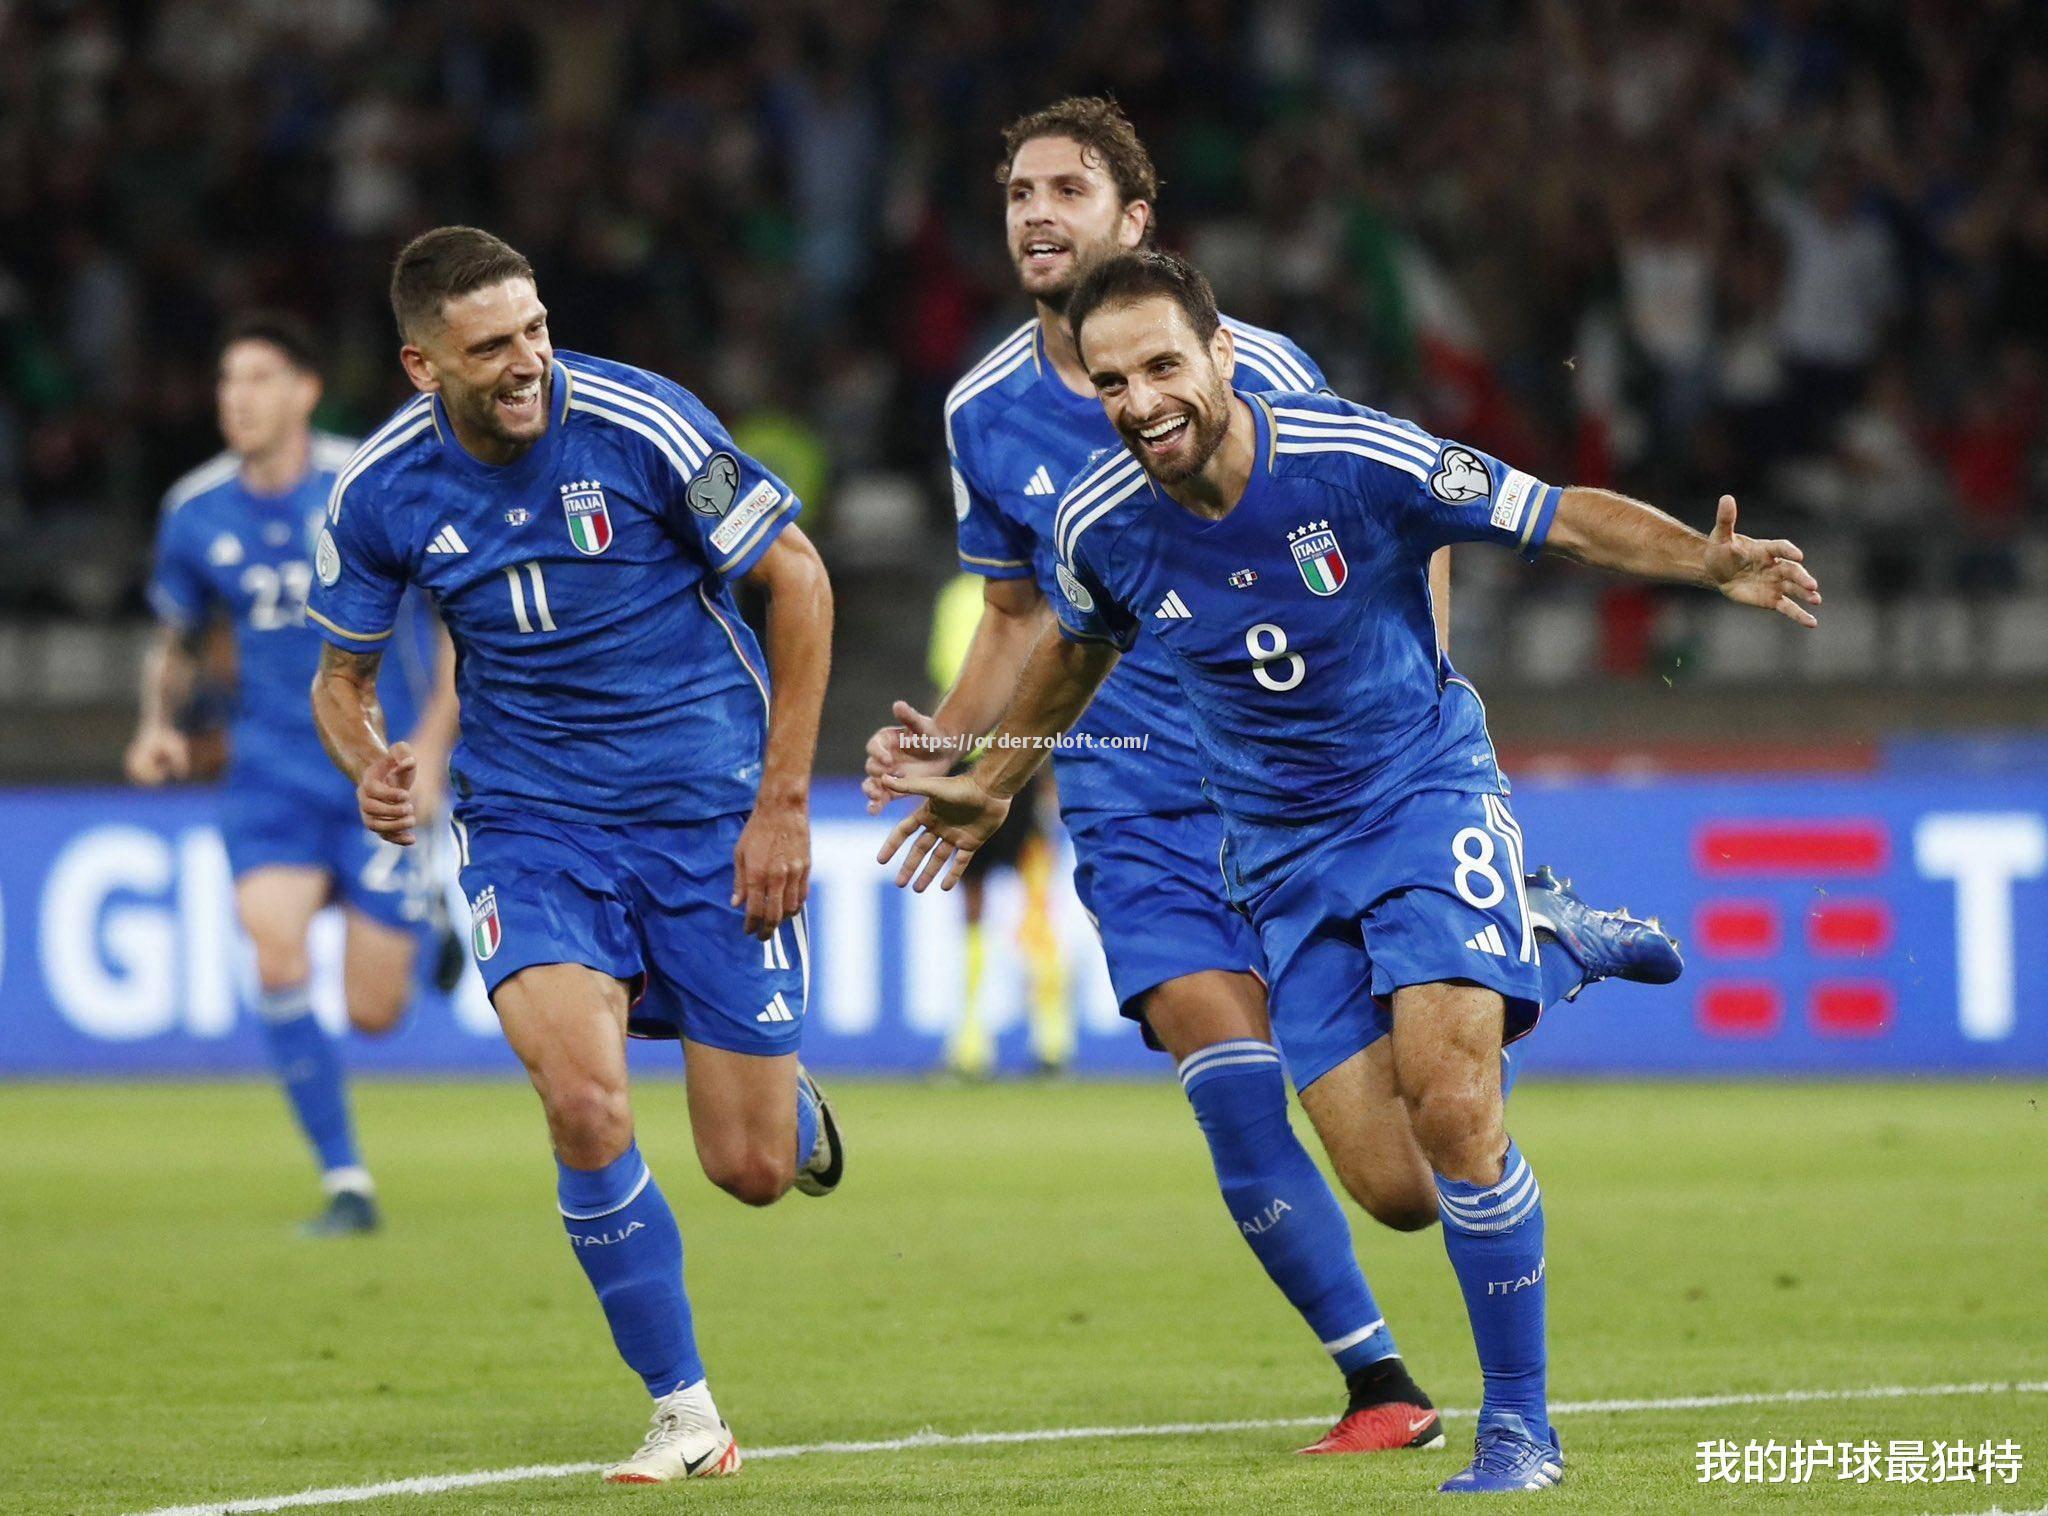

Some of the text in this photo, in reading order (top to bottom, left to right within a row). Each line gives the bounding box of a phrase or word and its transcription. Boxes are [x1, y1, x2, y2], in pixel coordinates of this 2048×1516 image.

[567, 496, 602, 512] ITALIA
[1294, 536, 1334, 559] ITALIA
[502, 560, 558, 634] 11
[1245, 623, 1306, 692] 8
[1451, 826, 1506, 909] 8
[567, 1221, 646, 1247] TALIA
[1241, 1198, 1292, 1234] ALIA
[1488, 1256, 1545, 1295] ITAL
